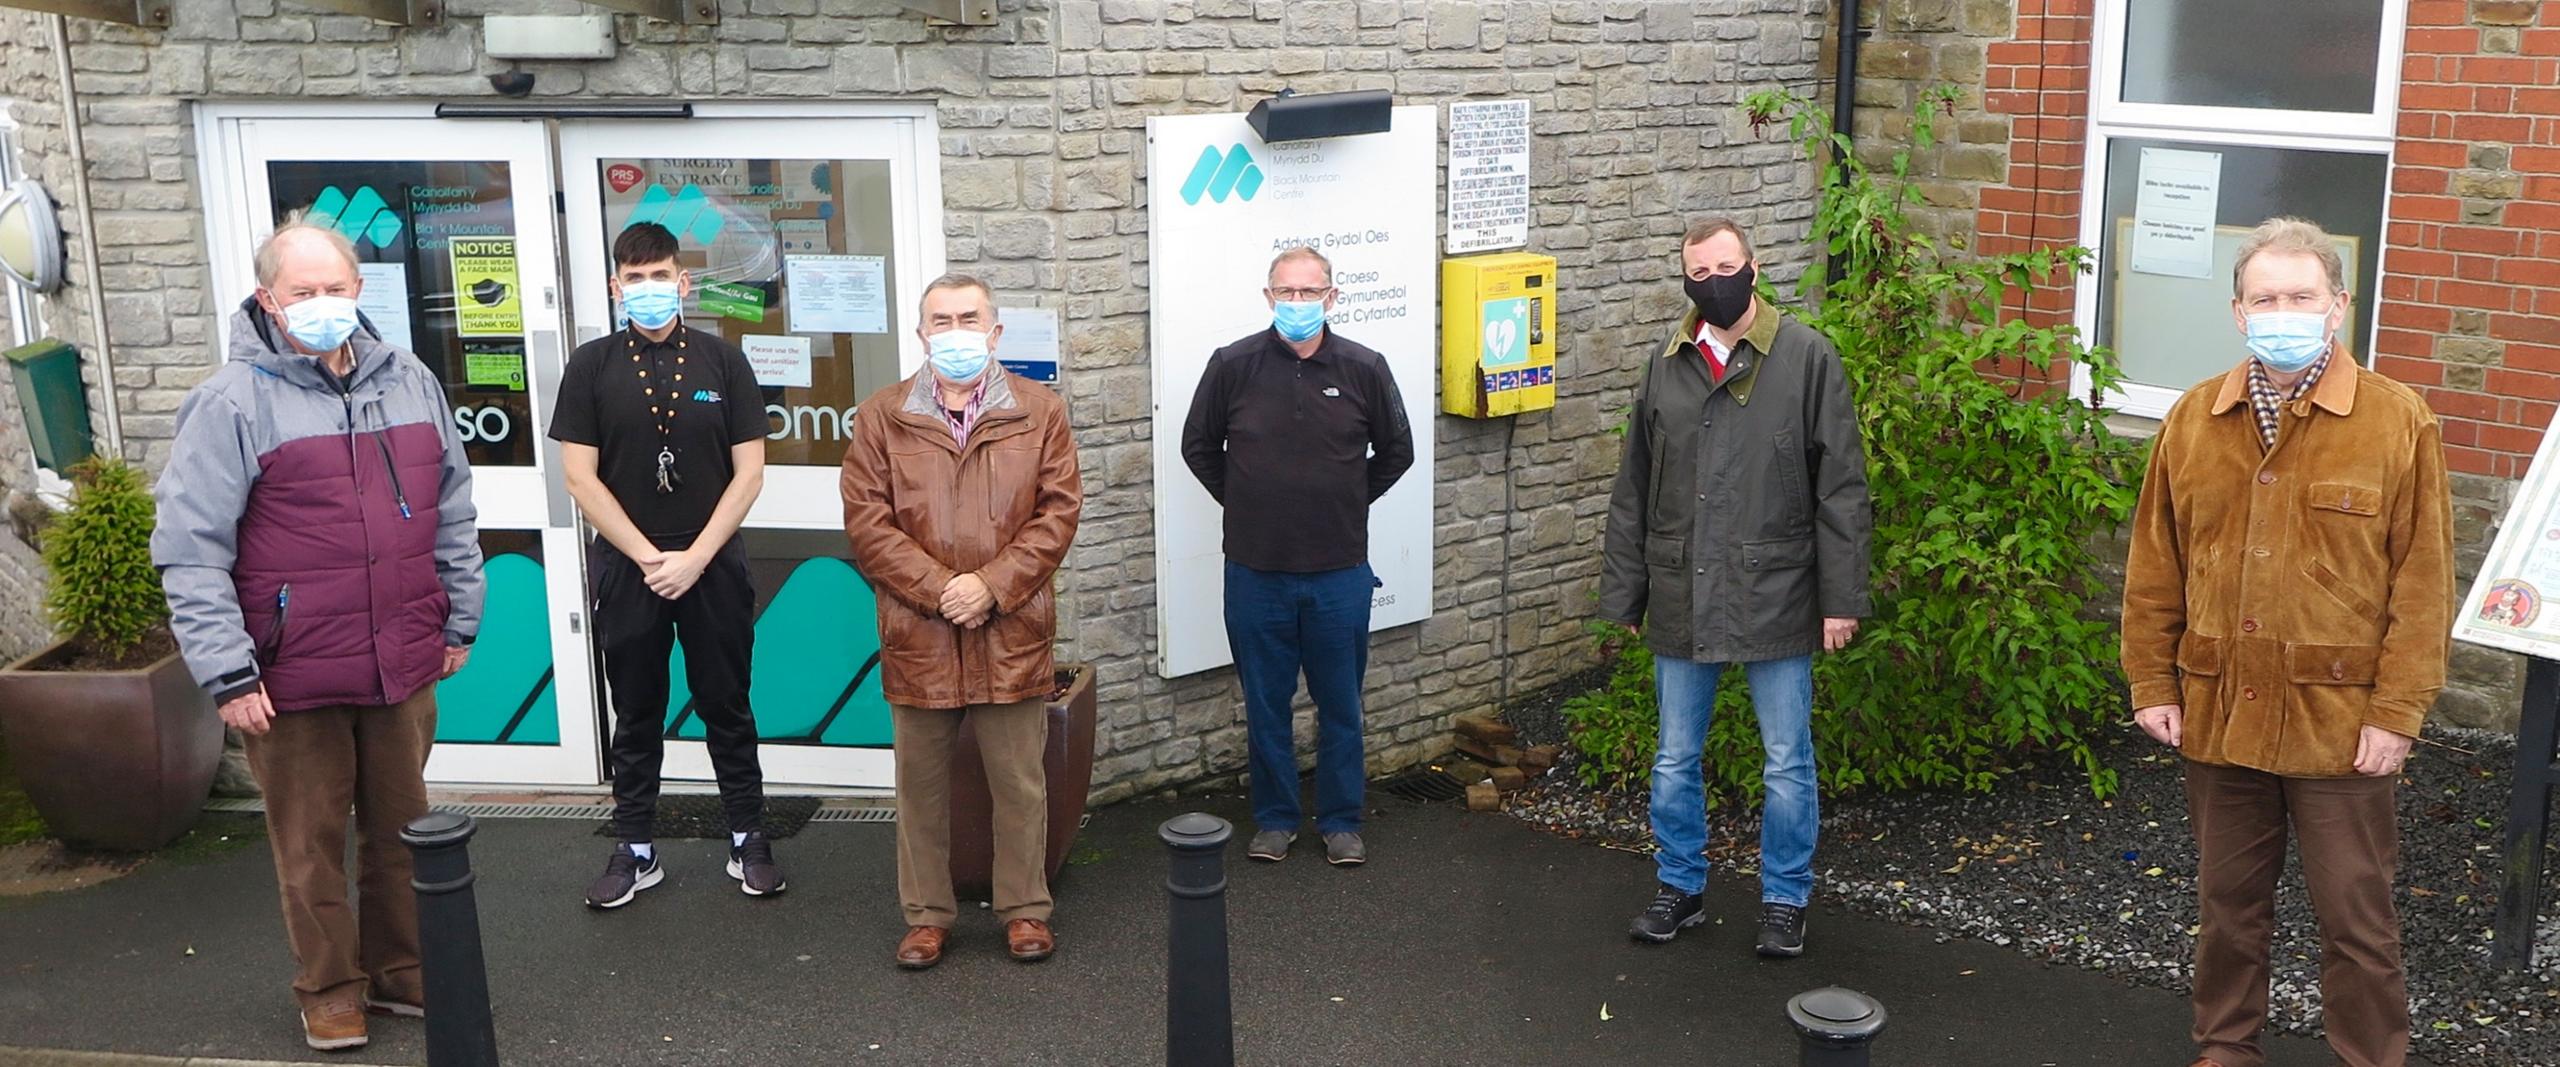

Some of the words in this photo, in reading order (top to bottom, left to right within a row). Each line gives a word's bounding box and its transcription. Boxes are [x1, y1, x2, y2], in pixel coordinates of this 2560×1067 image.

[664, 159, 735, 168] SURGERY
[1312, 153, 1325, 163] Du
[611, 169, 635, 181] PRS
[659, 173, 742, 186] ENTRANCE
[411, 186, 467, 198] Canolfan
[470, 187, 476, 199] y
[412, 201, 463, 215] Mynydd
[463, 201, 481, 213] Du
[1460, 212, 1471, 220] THE
[1505, 207, 1526, 216] PERSON
[415, 223, 447, 234] Blak
[449, 223, 505, 234] Mountain
[1477, 228, 1497, 238] THIS
[1324, 232, 1362, 249] Gydol
[1365, 230, 1389, 244] Oes
[456, 242, 513, 255] NOTICE
[1336, 271, 1379, 285] Croeso
[1335, 286, 1407, 305] Gymunedol
[1353, 304, 1407, 324] Cyfarfod
[499, 320, 519, 328] YOU
[750, 345, 773, 353] Please
[751, 356, 769, 364] hand
[455, 406, 510, 442] so
[765, 404, 858, 441] ome
[1371, 593, 1396, 608] cess
